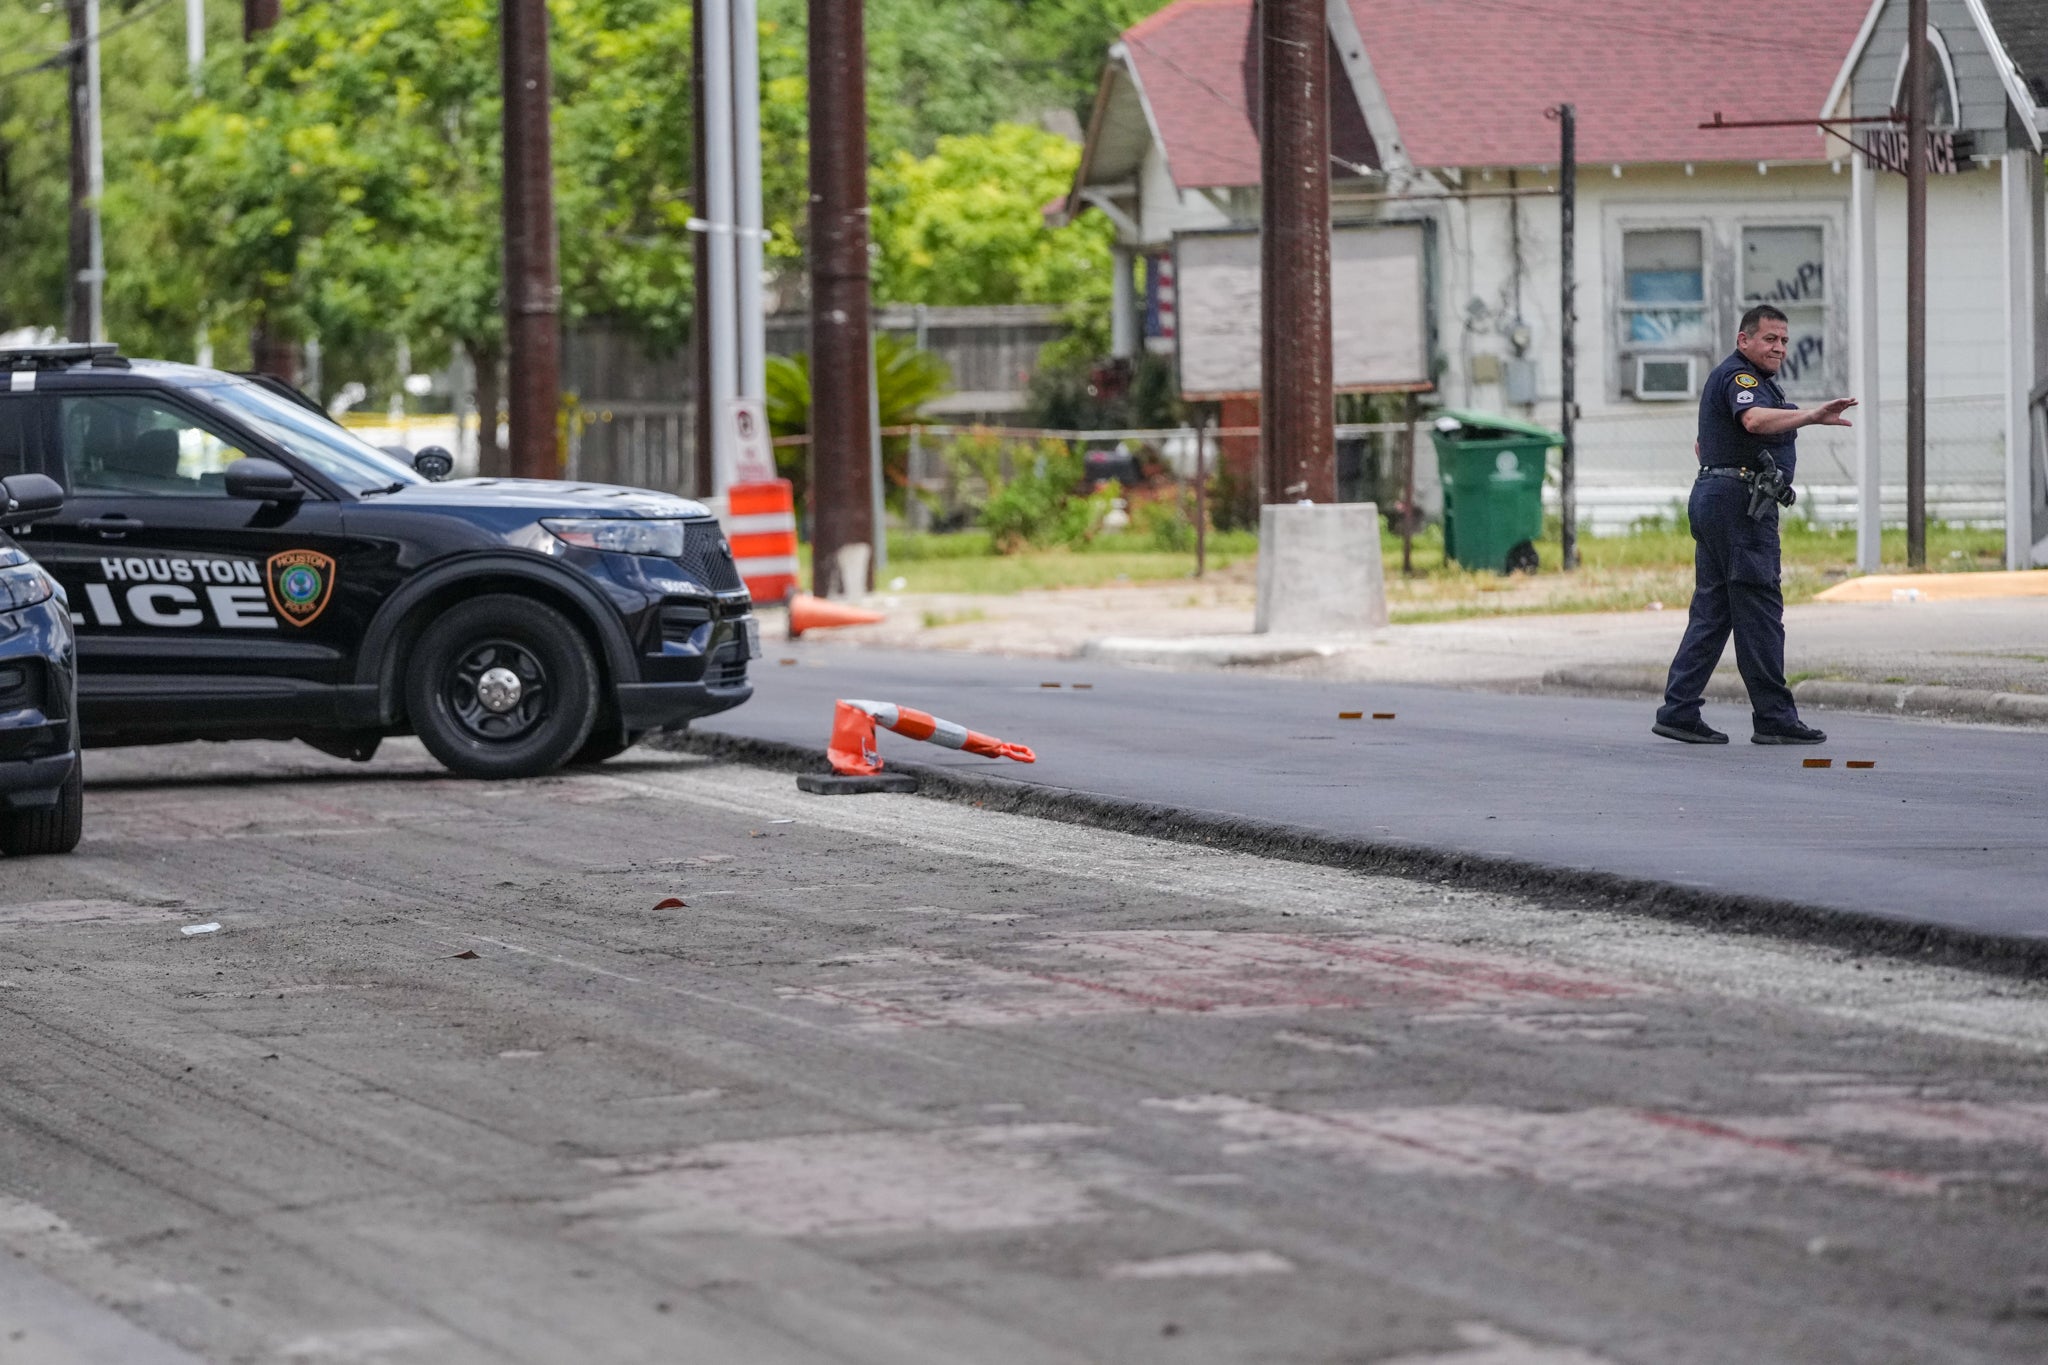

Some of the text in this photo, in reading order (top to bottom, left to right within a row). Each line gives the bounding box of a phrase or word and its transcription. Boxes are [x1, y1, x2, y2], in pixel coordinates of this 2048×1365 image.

[1866, 130, 1958, 174] INSURNCE
[101, 557, 262, 584] HOUSTON
[276, 553, 327, 568] HOUSTON
